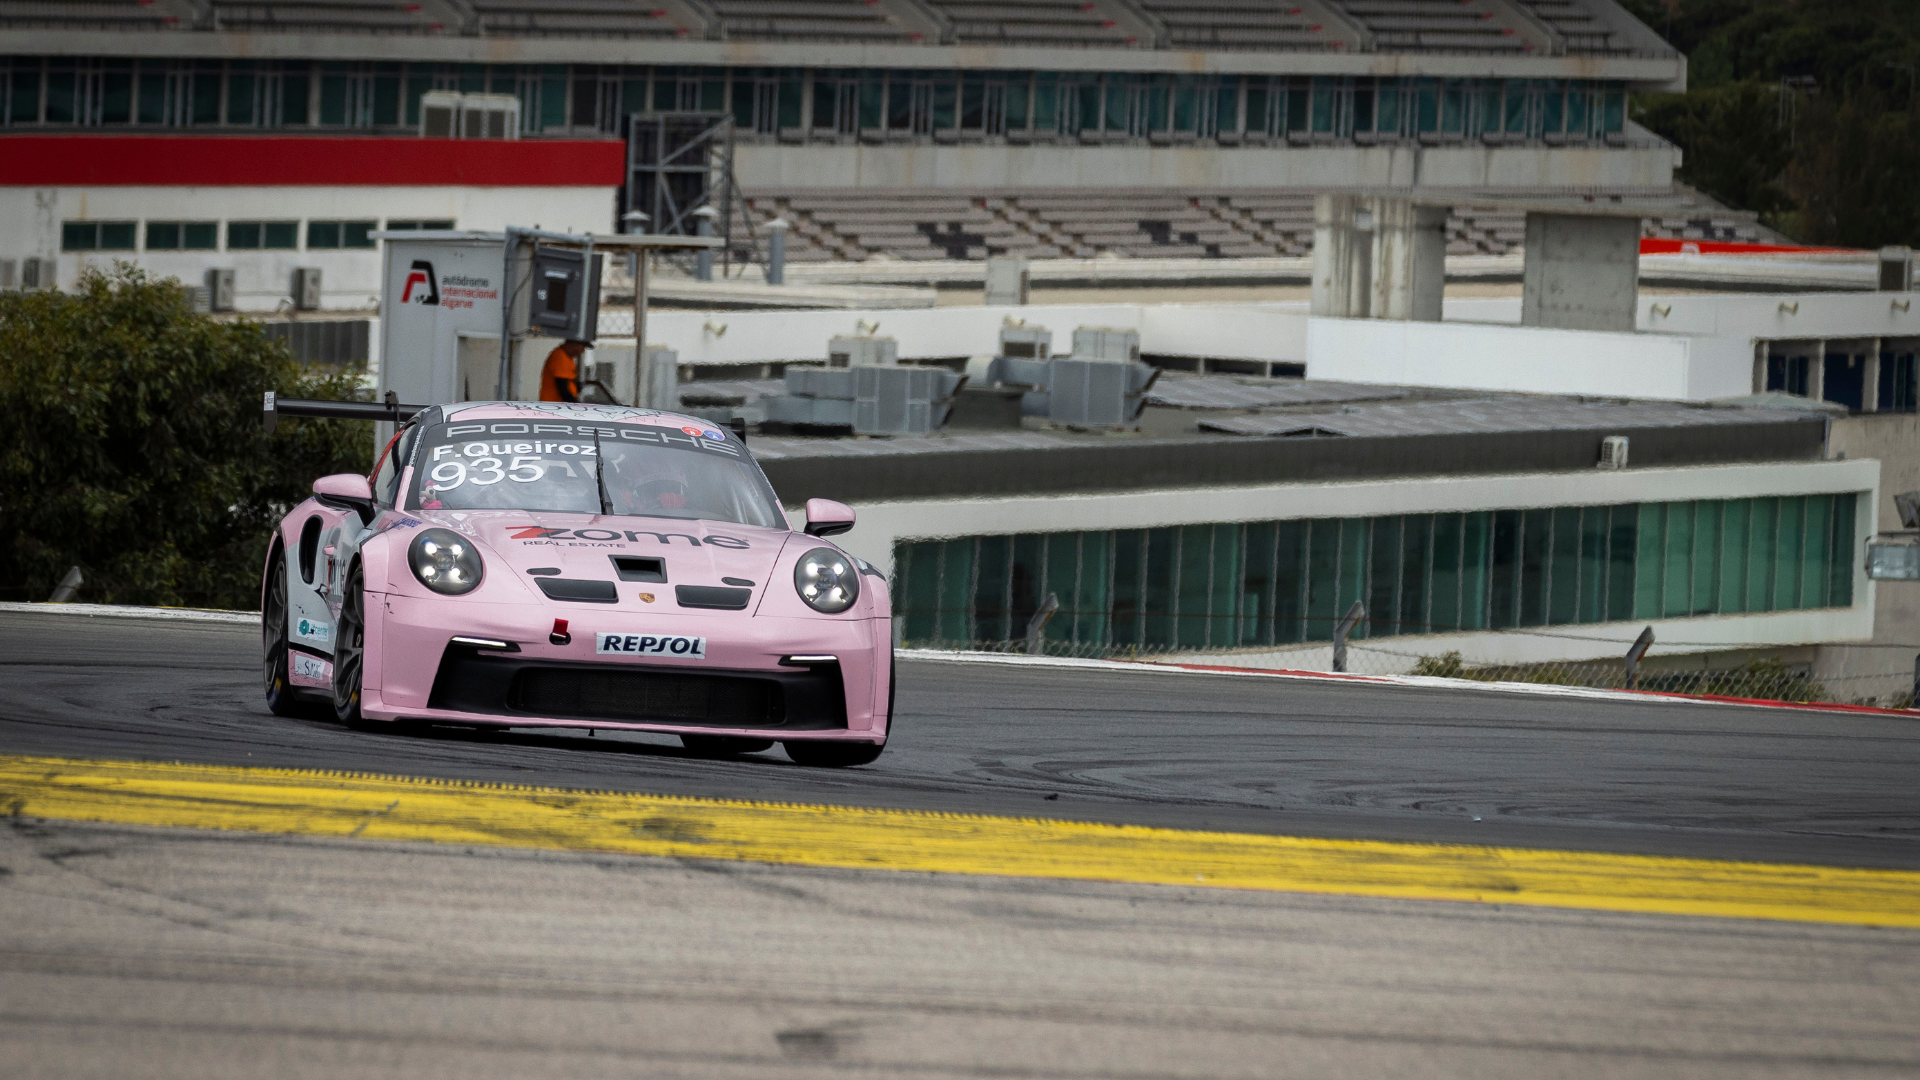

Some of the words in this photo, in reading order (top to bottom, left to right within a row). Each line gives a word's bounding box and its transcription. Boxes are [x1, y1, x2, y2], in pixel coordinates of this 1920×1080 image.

[441, 286, 498, 299] internacional
[441, 298, 474, 310] algarve
[446, 423, 740, 457] PORSCHE
[433, 441, 598, 461] F.Queiroz
[431, 456, 544, 491] 935
[523, 539, 566, 547] REAL
[569, 541, 626, 549] ESTATE
[602, 635, 702, 655] REPSOL
